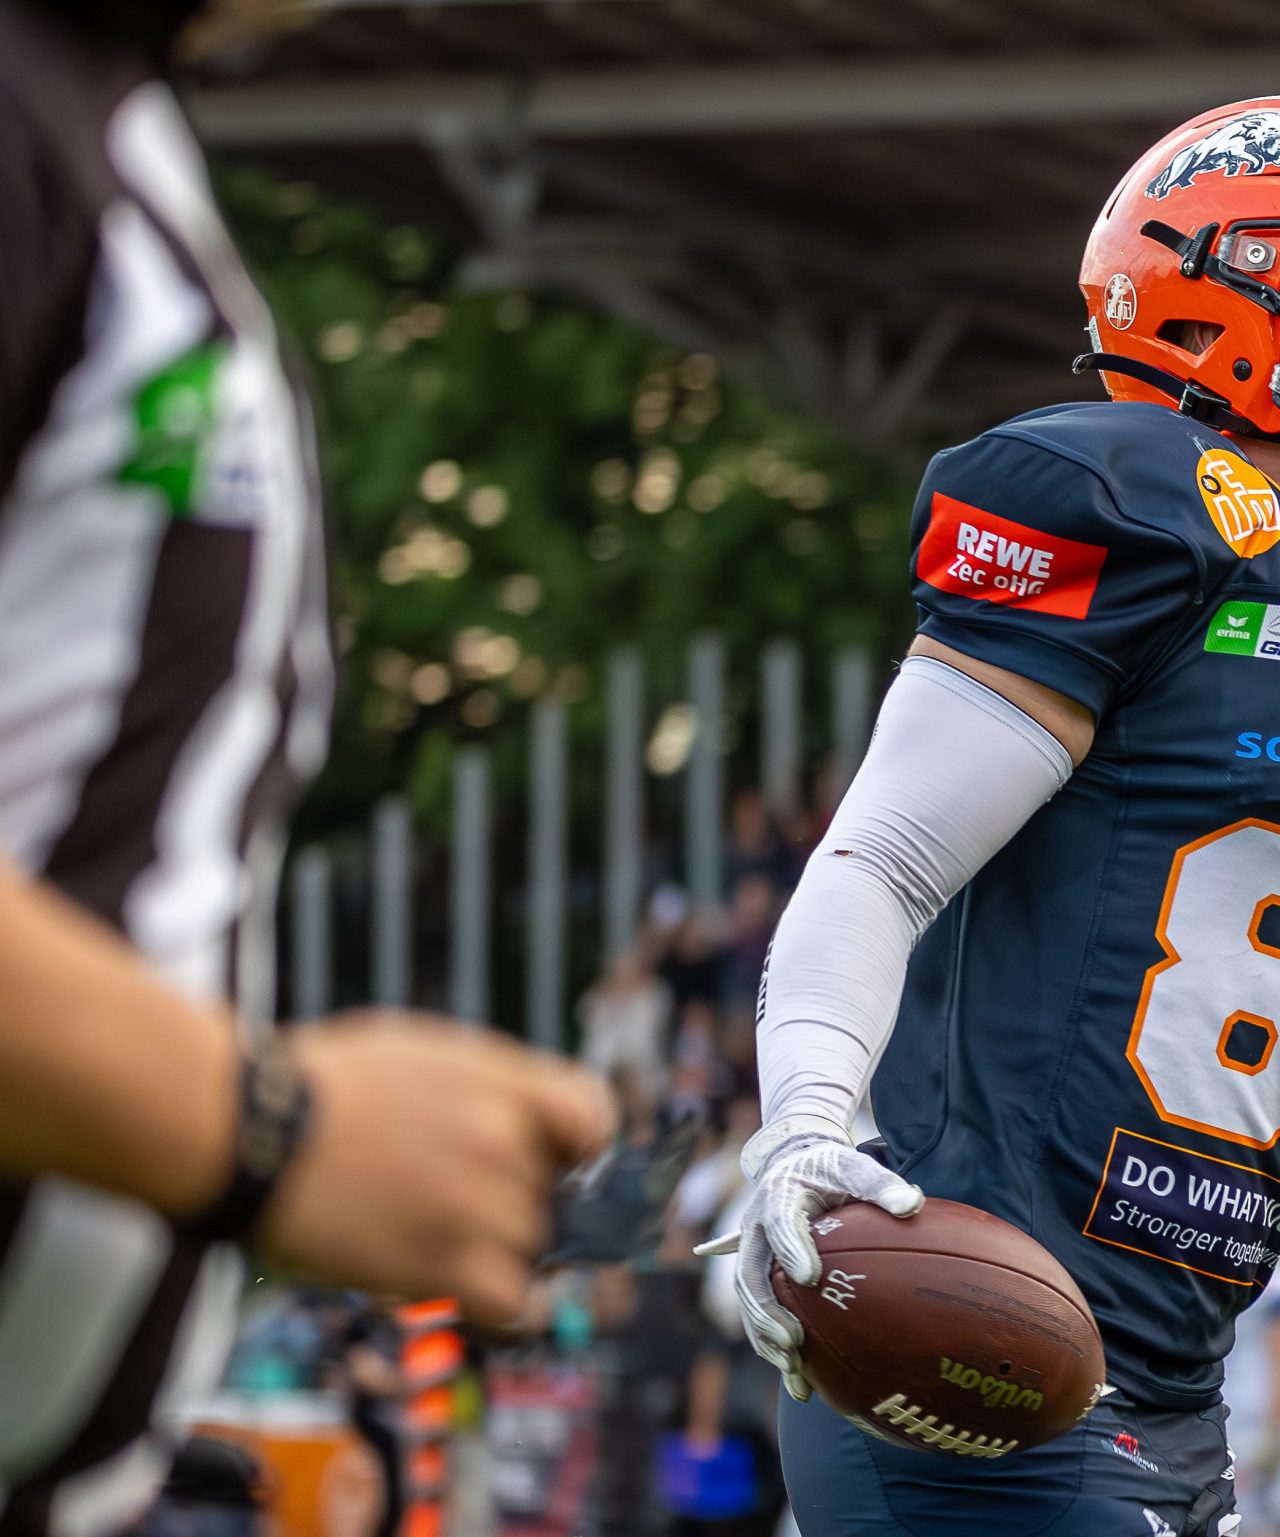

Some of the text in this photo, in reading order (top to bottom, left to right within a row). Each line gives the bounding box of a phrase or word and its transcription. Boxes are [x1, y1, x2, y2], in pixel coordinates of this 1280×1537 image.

[947, 554, 986, 586] Zec
[956, 522, 1054, 579] REWE
[1216, 628, 1250, 640] erima
[1121, 1155, 1176, 1197] DO
[1188, 1174, 1263, 1224] WHAT
[1110, 1200, 1222, 1252] Stronger
[821, 1269, 867, 1310] RR
